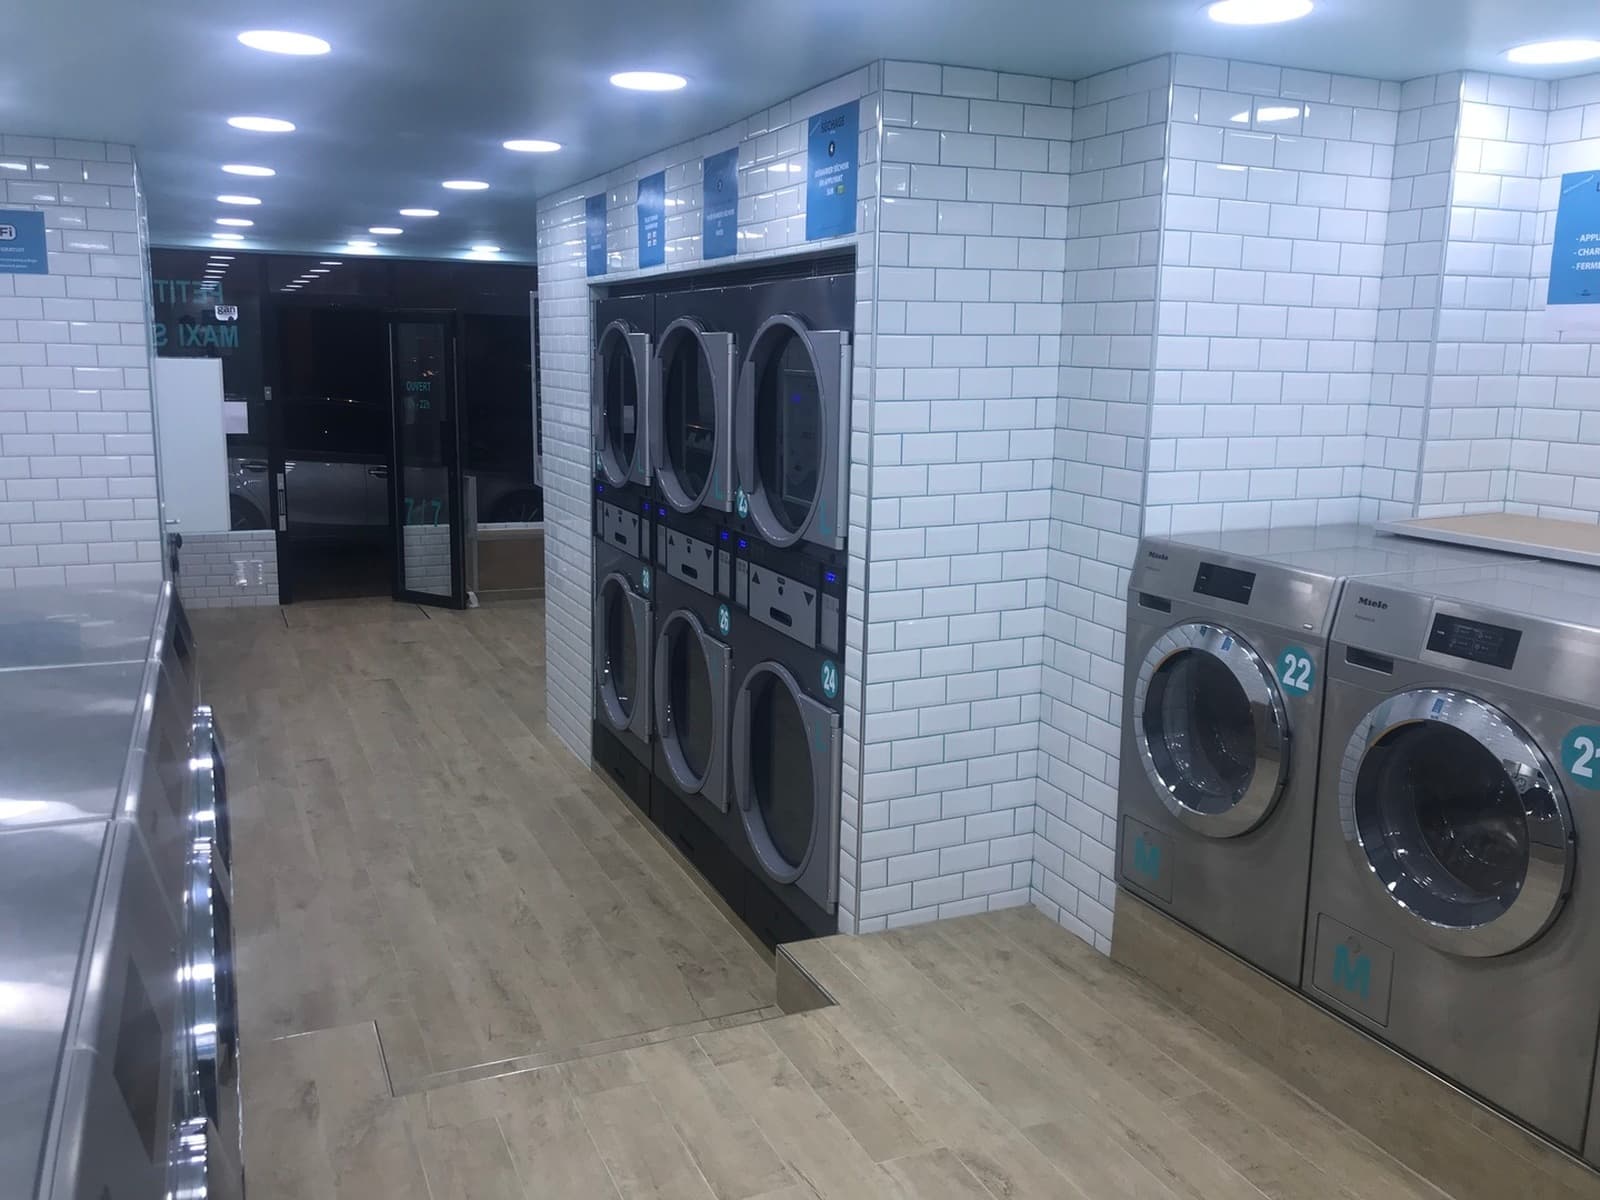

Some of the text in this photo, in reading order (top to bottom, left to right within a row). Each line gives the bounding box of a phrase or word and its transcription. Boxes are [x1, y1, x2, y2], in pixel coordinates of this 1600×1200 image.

[1358, 596, 1389, 611] Miele
[823, 665, 836, 693] 24
[1282, 653, 1311, 691] 22
[1571, 736, 1600, 778] 2
[1134, 836, 1161, 881] M
[1332, 943, 1371, 1000] M
